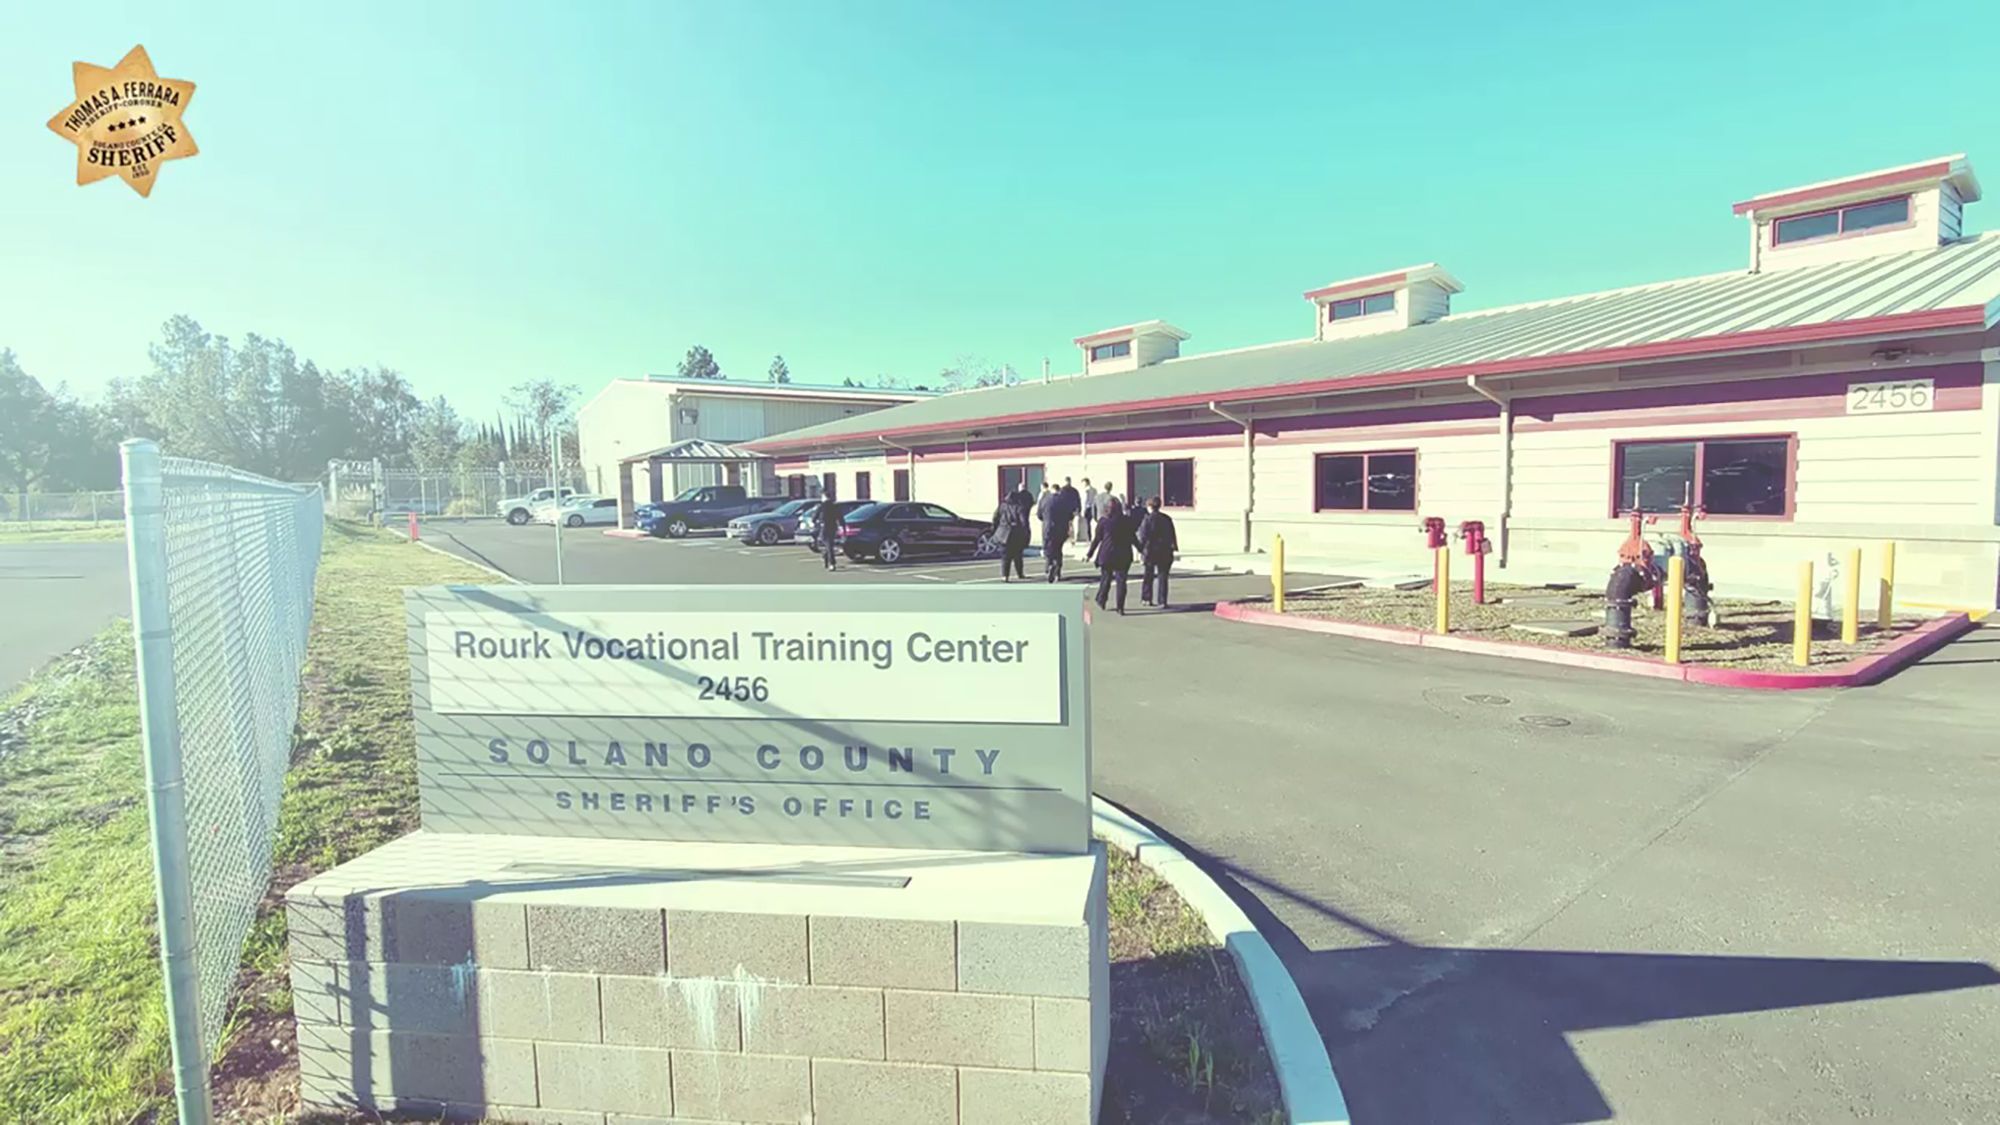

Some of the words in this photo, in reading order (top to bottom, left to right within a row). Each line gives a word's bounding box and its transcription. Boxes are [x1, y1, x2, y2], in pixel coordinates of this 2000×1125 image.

[1852, 383, 1927, 410] 2456
[454, 631, 551, 659] Rourk
[562, 631, 739, 660] Vocational
[752, 632, 892, 669] Training
[906, 632, 1029, 663] Center
[697, 676, 769, 702] 2456
[488, 738, 712, 768] SOLANO
[756, 744, 1000, 775] COUNTY
[556, 791, 756, 815] SHERIFF'S
[783, 797, 930, 820] OFFICE
